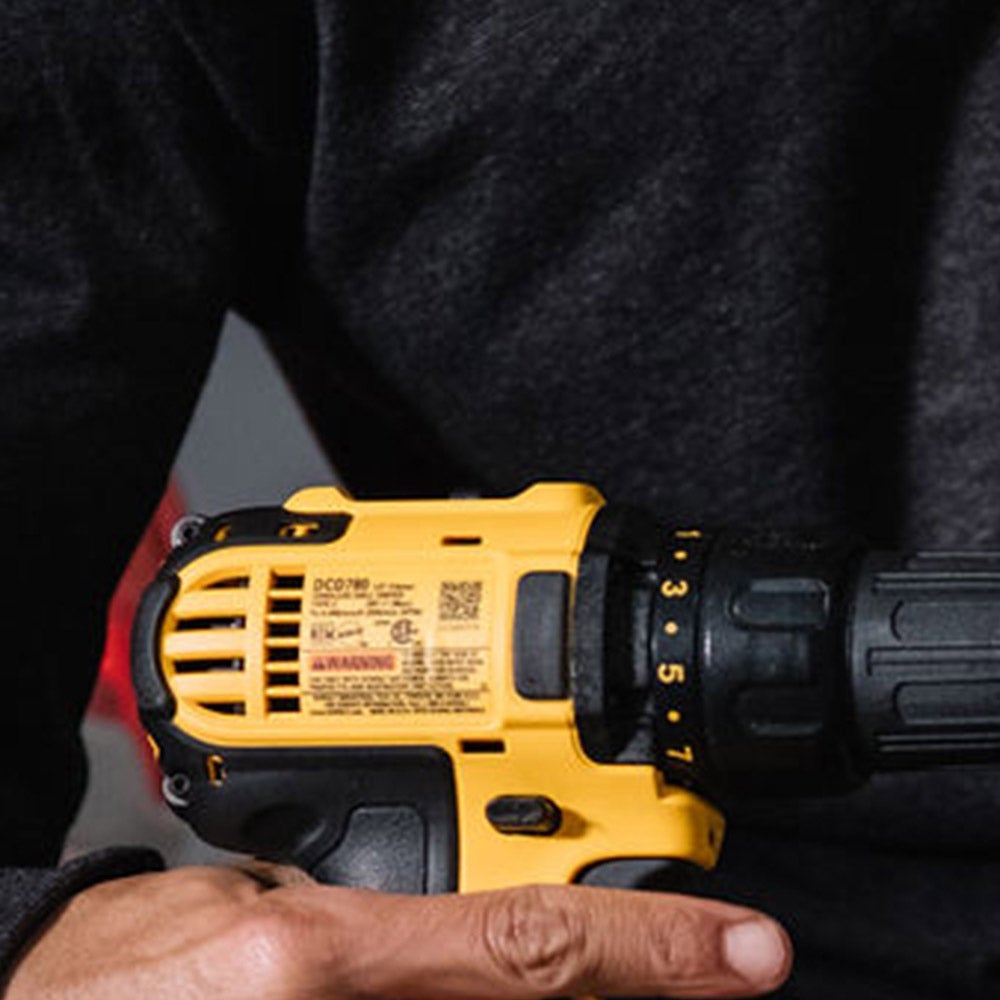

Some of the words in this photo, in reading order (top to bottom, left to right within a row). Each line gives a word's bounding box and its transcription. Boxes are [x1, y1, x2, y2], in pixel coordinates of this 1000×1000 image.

[660, 579, 689, 597] 3
[656, 663, 685, 684] 5
[666, 746, 694, 763] 7
